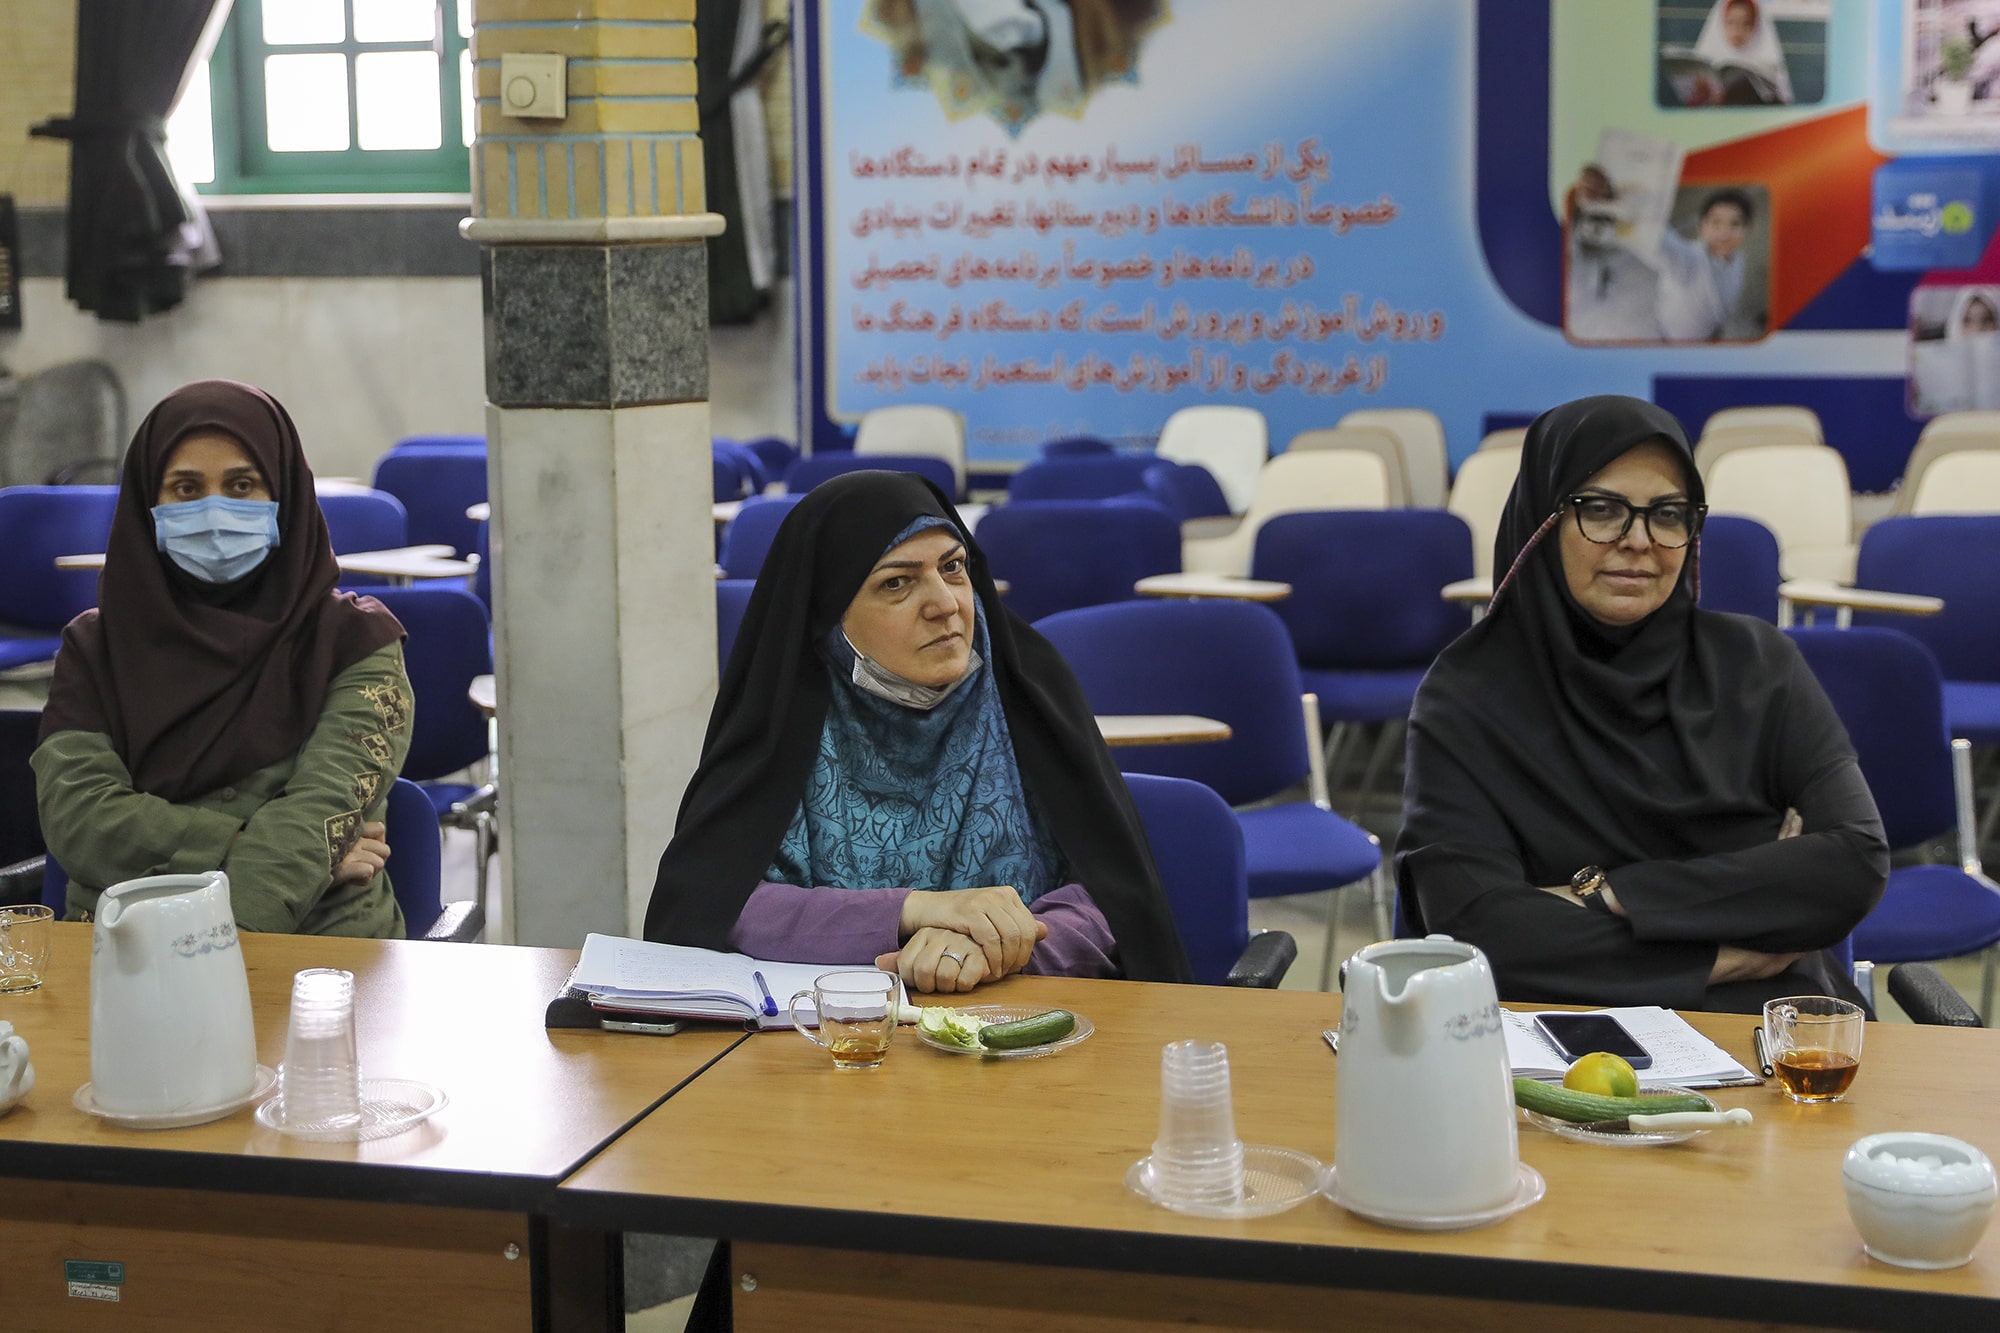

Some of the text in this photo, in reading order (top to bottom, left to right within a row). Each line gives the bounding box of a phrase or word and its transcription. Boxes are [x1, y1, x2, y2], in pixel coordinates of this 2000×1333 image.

[1011, 152, 1038, 185] در
[1044, 152, 1090, 189] مهم
[1260, 143, 1285, 182] از
[1144, 206, 1160, 235] و
[1158, 260, 1175, 288] و
[1283, 253, 1315, 288] در
[1249, 311, 1264, 341] و
[1356, 300, 1425, 341] روش
[1428, 311, 1444, 341] و
[1205, 354, 1228, 392] از
[1230, 365, 1247, 392] و
[1363, 355, 1387, 393] از
